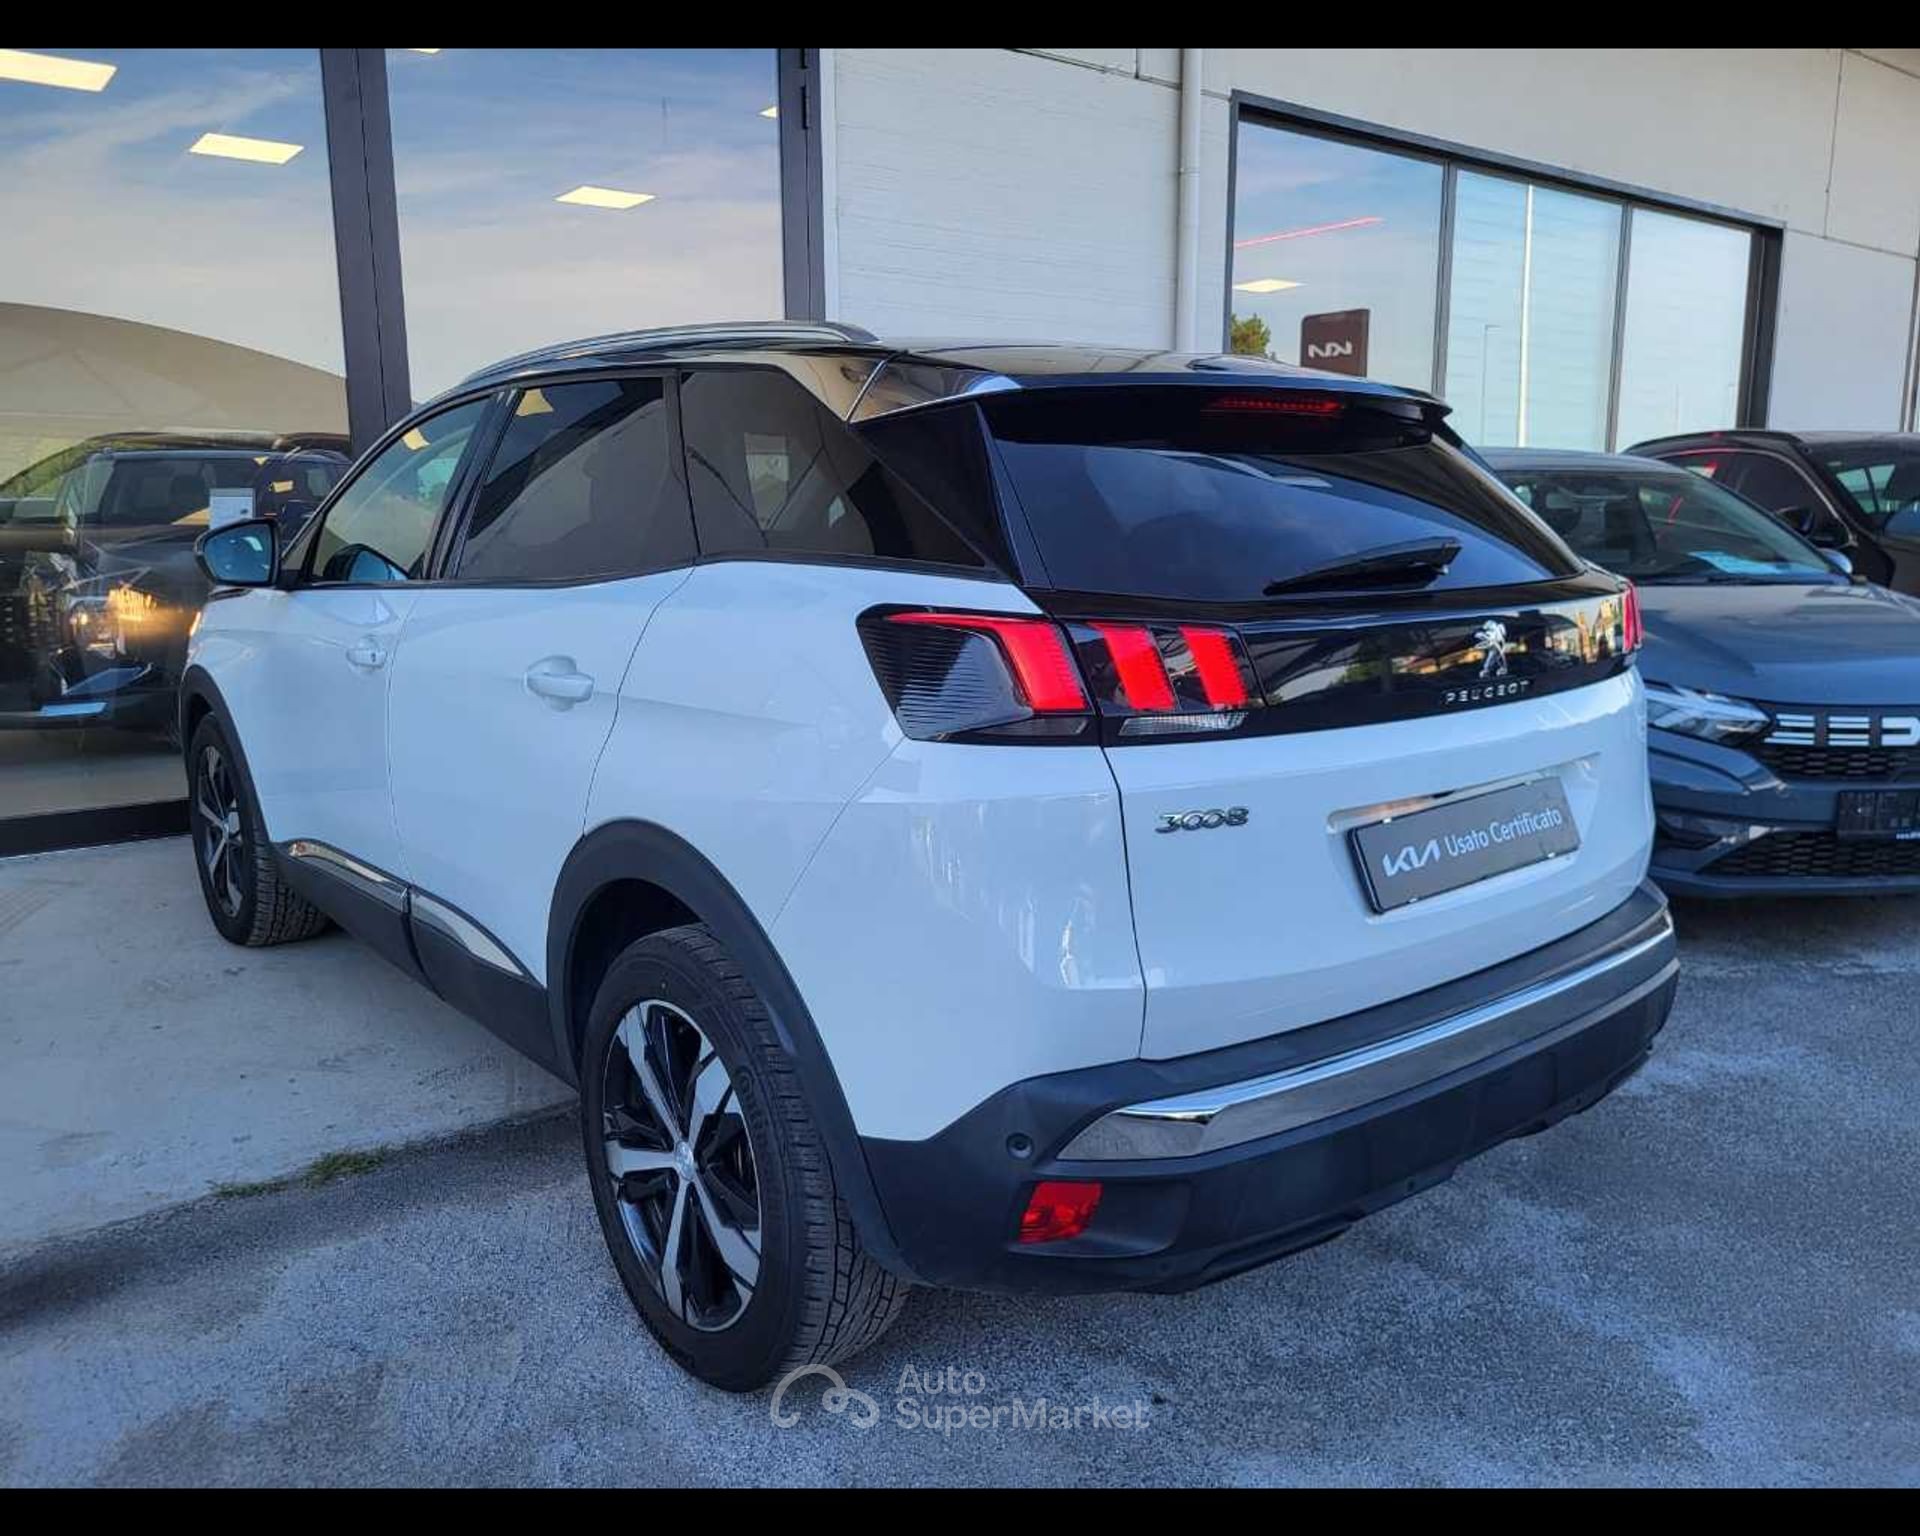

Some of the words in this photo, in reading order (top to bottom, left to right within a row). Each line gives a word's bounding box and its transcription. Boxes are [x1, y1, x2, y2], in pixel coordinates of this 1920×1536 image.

[1444, 680, 1530, 705] PEUGEOT
[1154, 807, 1249, 834] 3008
[1444, 831, 1489, 857] Usato
[1490, 807, 1562, 842] Certificato
